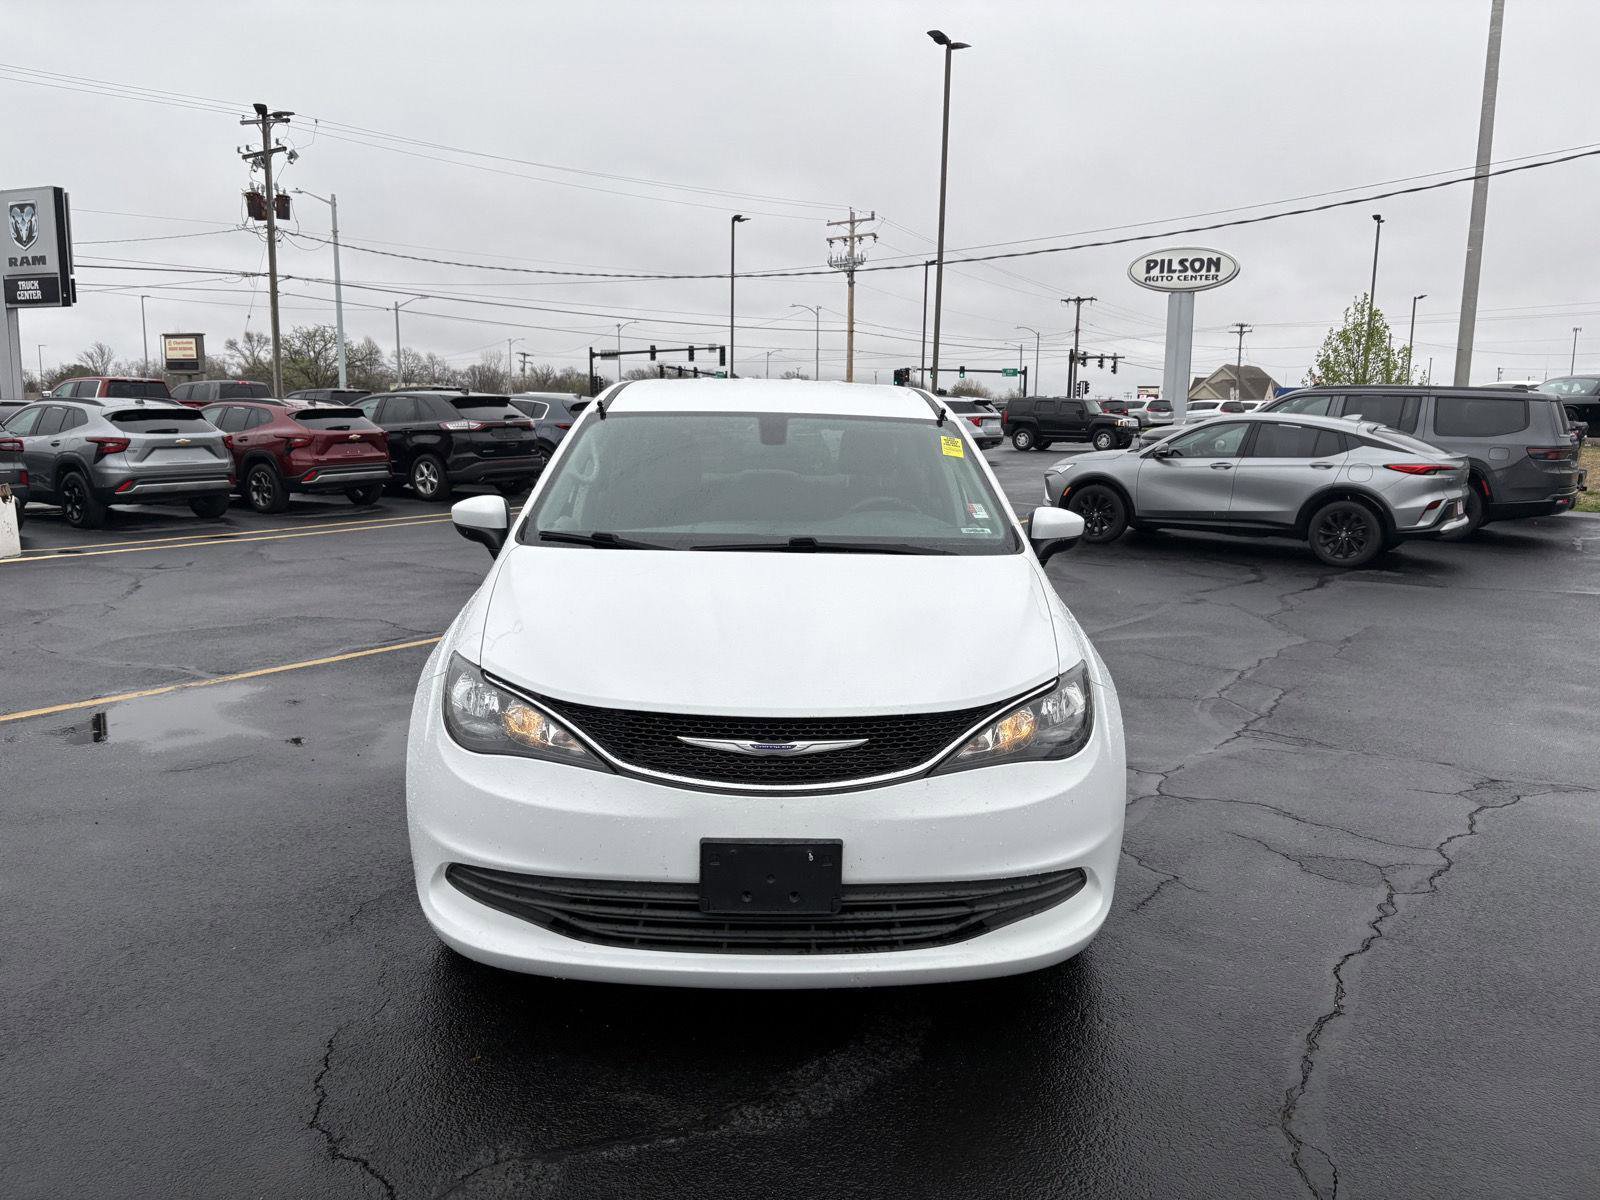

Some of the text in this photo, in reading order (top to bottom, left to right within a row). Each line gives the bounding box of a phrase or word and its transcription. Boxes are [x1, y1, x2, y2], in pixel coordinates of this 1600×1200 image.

[8, 255, 47, 267] RAM
[1145, 257, 1222, 274] PILSON
[1144, 274, 1219, 283] AUTO CENTER
[17, 280, 40, 290] TRUCK
[16, 290, 42, 300] CENTER
